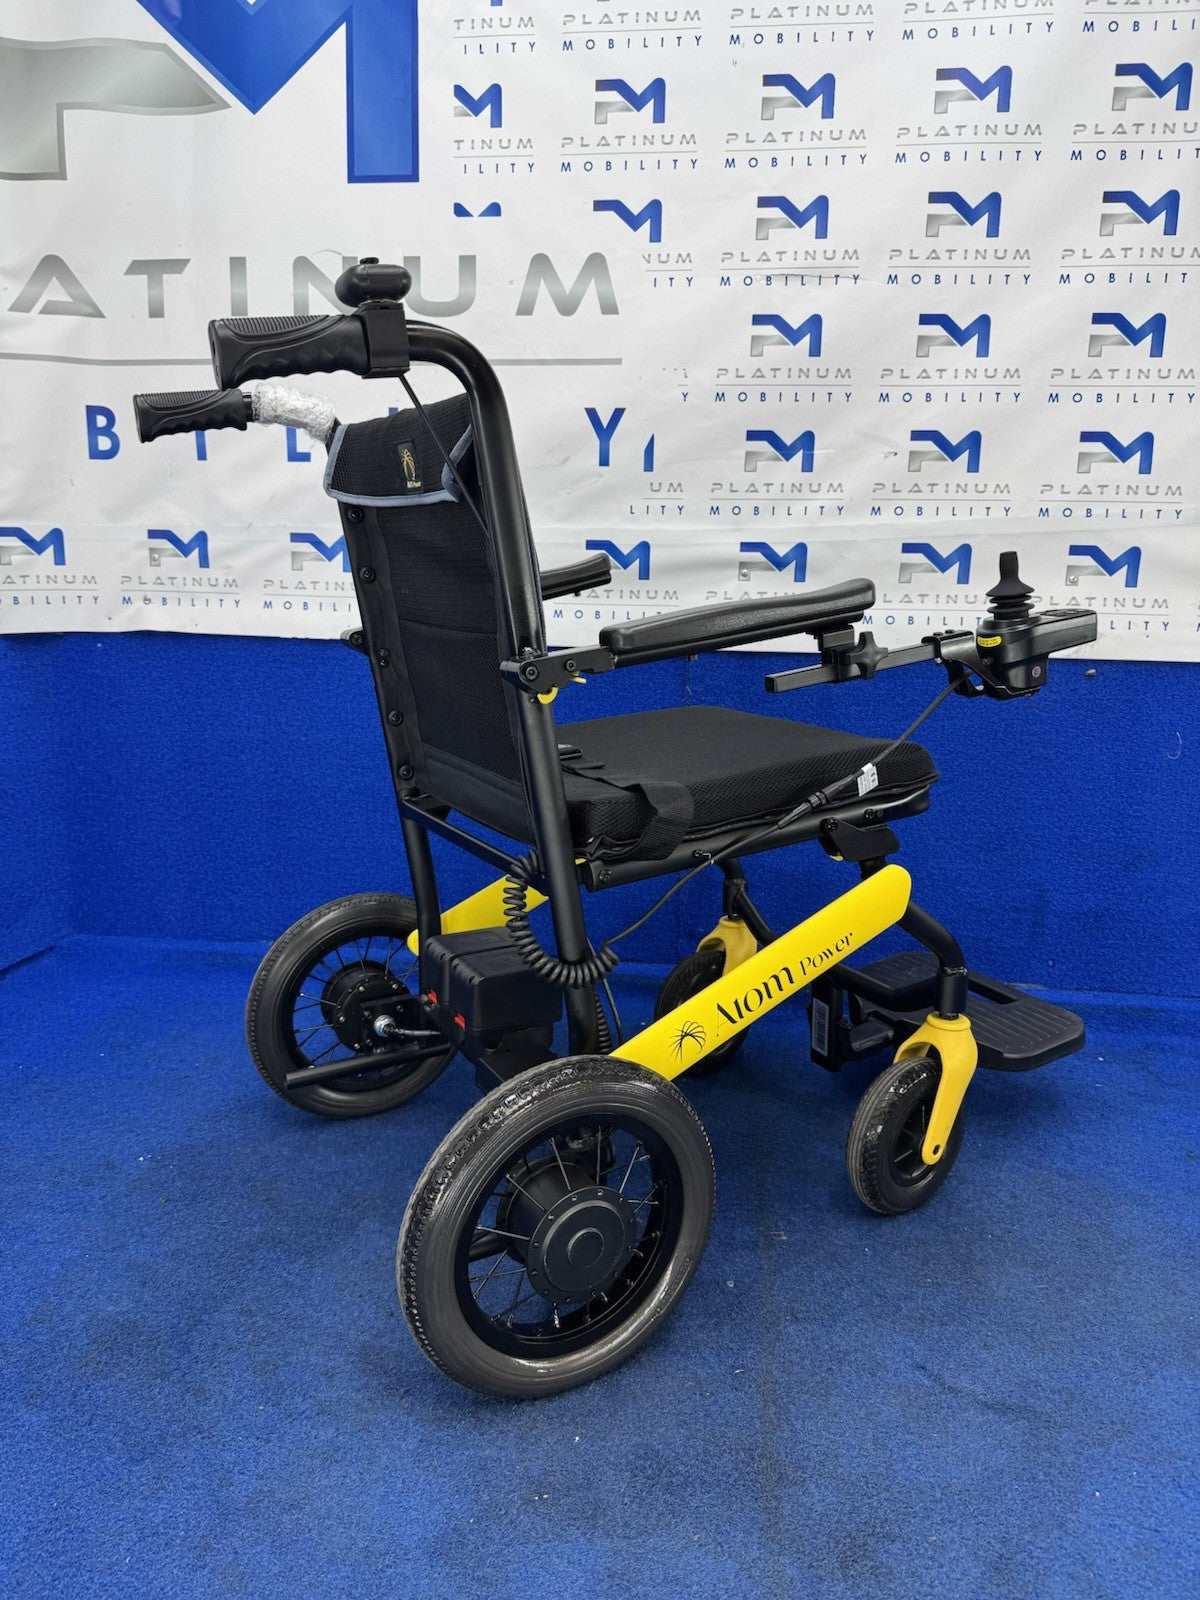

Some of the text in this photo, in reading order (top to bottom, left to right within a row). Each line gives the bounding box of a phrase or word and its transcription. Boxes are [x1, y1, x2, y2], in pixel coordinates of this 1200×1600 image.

[563, 9, 701, 26] PLATINUM
[730, 4, 873, 19] PLATINUM
[454, 16, 535, 30] TINUM
[902, 21, 1053, 40] MOBILITY
[562, 35, 701, 51] MOBILITY
[729, 29, 874, 47] MOBILITY
[464, 41, 536, 55] ILITY
[726, 128, 867, 144] PLATINUM
[896, 123, 1042, 139] PLATINUM
[454, 138, 534, 150] TINUM
[561, 133, 697, 148] PLATINUM
[725, 154, 867, 168] MOBILITY
[894, 150, 1042, 163] MOBILITY
[464, 163, 535, 174] ILITY
[561, 159, 698, 172] MOBILITY
[720, 249, 860, 263] PLATINUM
[889, 248, 1031, 260] PLATINUM
[719, 274, 860, 287] MOBILITY
[887, 274, 1031, 285] MOBILITY
[1059, 272, 1187, 284] MOBILIT
[8, 252, 619, 318] ATINUM
[716, 367, 852, 379] PLATINUM
[880, 367, 1021, 380] PLATINUM
[1050, 367, 1196, 380] PLATINUM
[714, 392, 853, 402] MOBILITY
[878, 392, 1021, 403] MOBILITY
[1048, 392, 1196, 404] MOBILITY
[710, 482, 844, 493] PLATINUM
[872, 482, 1011, 495] PLATINUM
[1039, 484, 1183, 496] PLATINUM
[629, 504, 684, 515] LITY
[709, 504, 845, 516] MOBILITY
[870, 506, 1012, 517] MOBILITY
[1038, 506, 1183, 519] MOBILITY
[2, 574, 97, 584] ATINUM
[121, 575, 239, 588] PLATINUM
[263, 579, 355, 591] PLATIN
[0, 595, 99, 605] BILITY
[573, 589, 680, 600] ATINUM
[705, 590, 799, 600] PLATI
[882, 592, 989, 604] LATINU
[122, 595, 241, 608] MOBILITY
[263, 600, 351, 612] MOBILI
[553, 609, 661, 619] MOBILI
[861, 615, 982, 626] MOBILIT
[800, 932, 853, 976] Power
